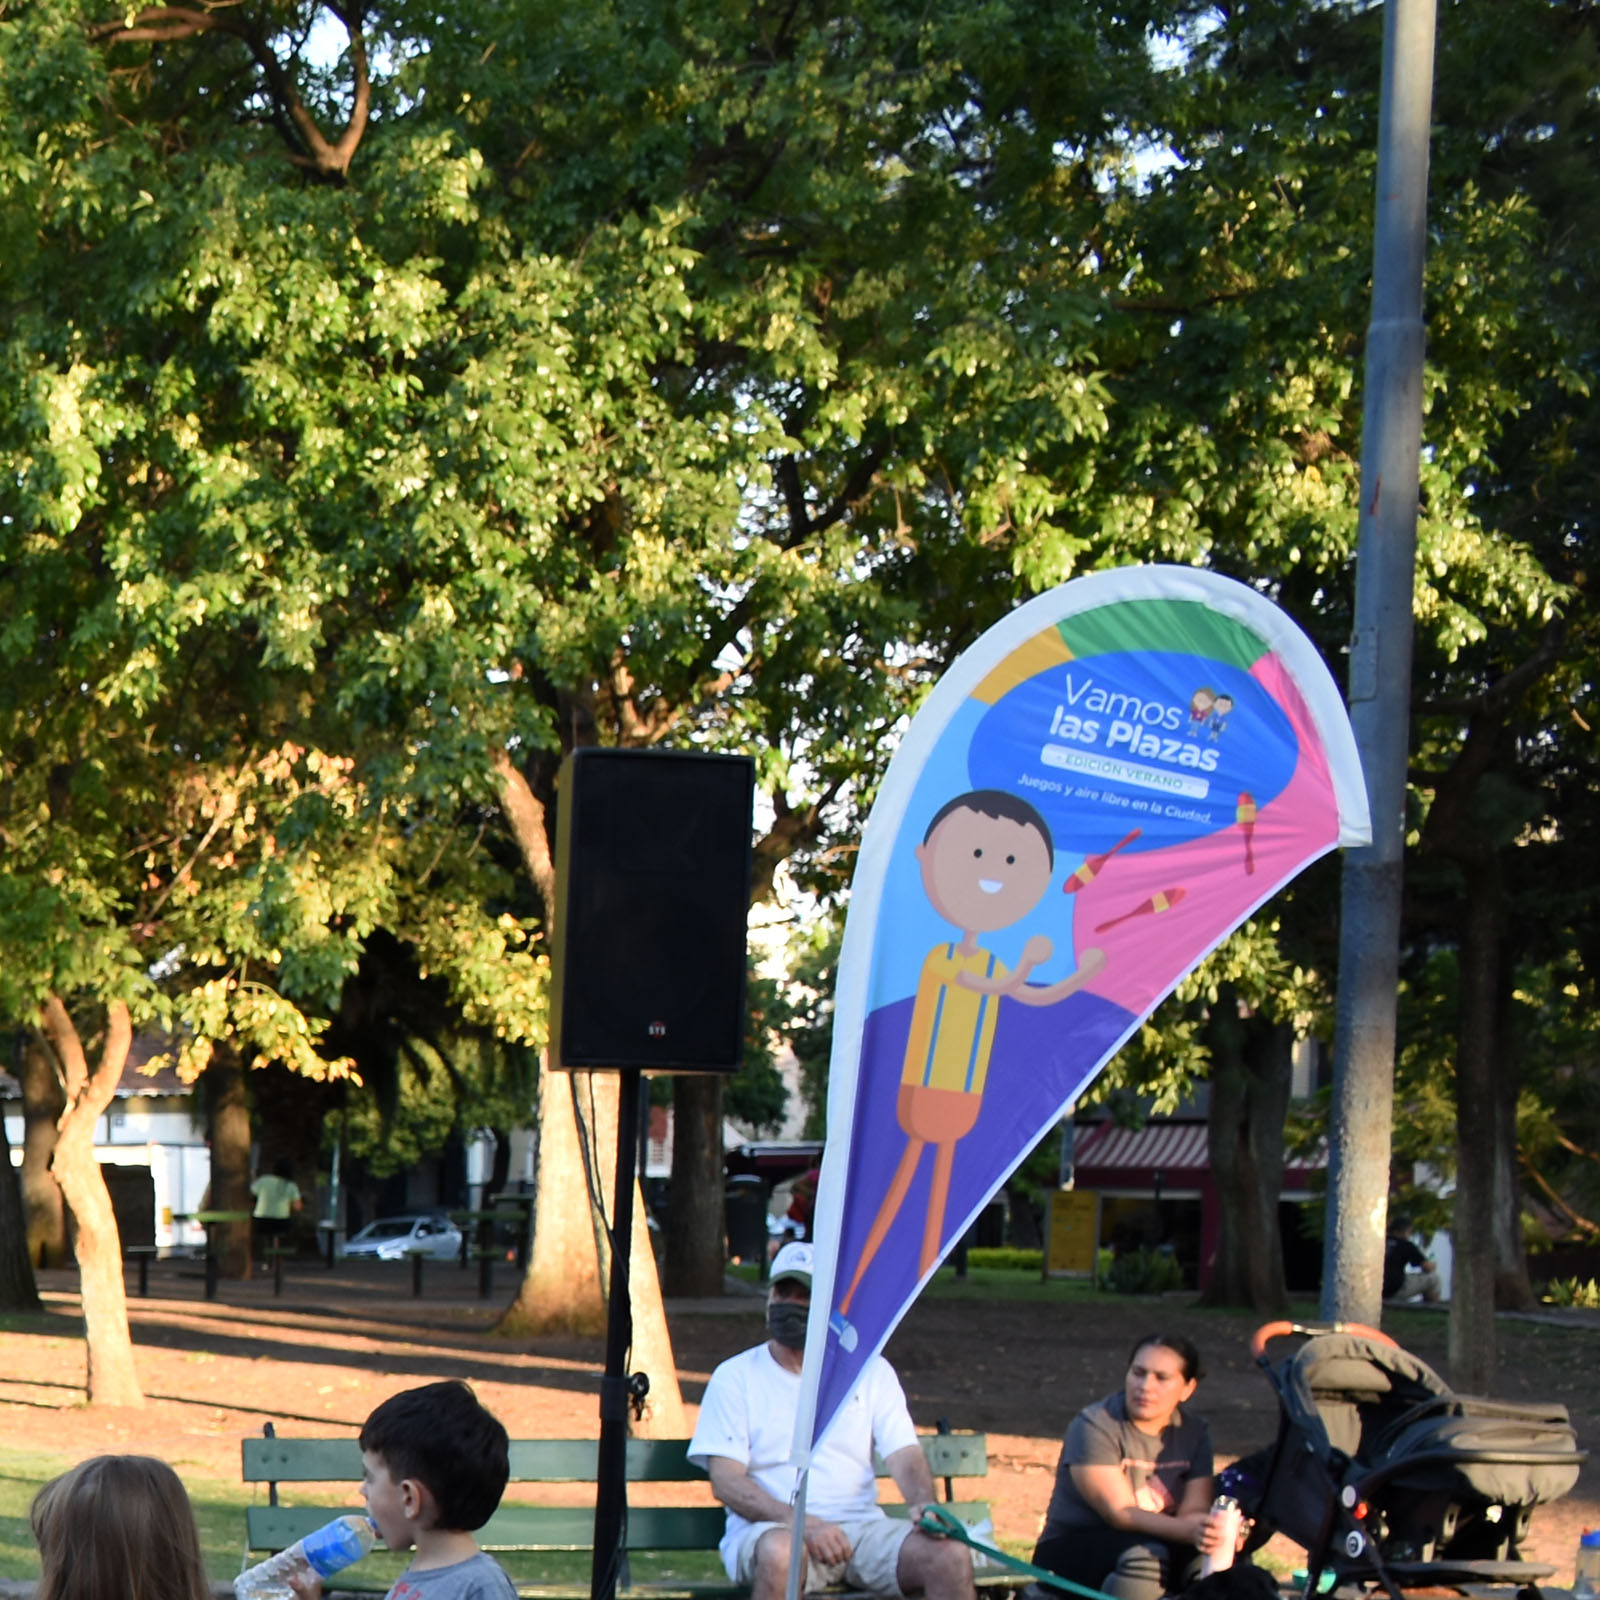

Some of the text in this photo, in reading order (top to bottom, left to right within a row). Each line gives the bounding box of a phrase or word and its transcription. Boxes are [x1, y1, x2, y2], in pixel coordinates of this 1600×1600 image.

[1066, 673, 1183, 730] Vamos
[1049, 705, 1220, 772] las Plazas
[1018, 773, 1062, 793] Juegos
[1064, 785, 1073, 796] y
[1075, 786, 1099, 801] aire
[1101, 791, 1130, 807] libre
[1132, 799, 1148, 812] en
[1150, 801, 1161, 815] la
[1065, 753, 1183, 789] EDICIÓN VERANO
